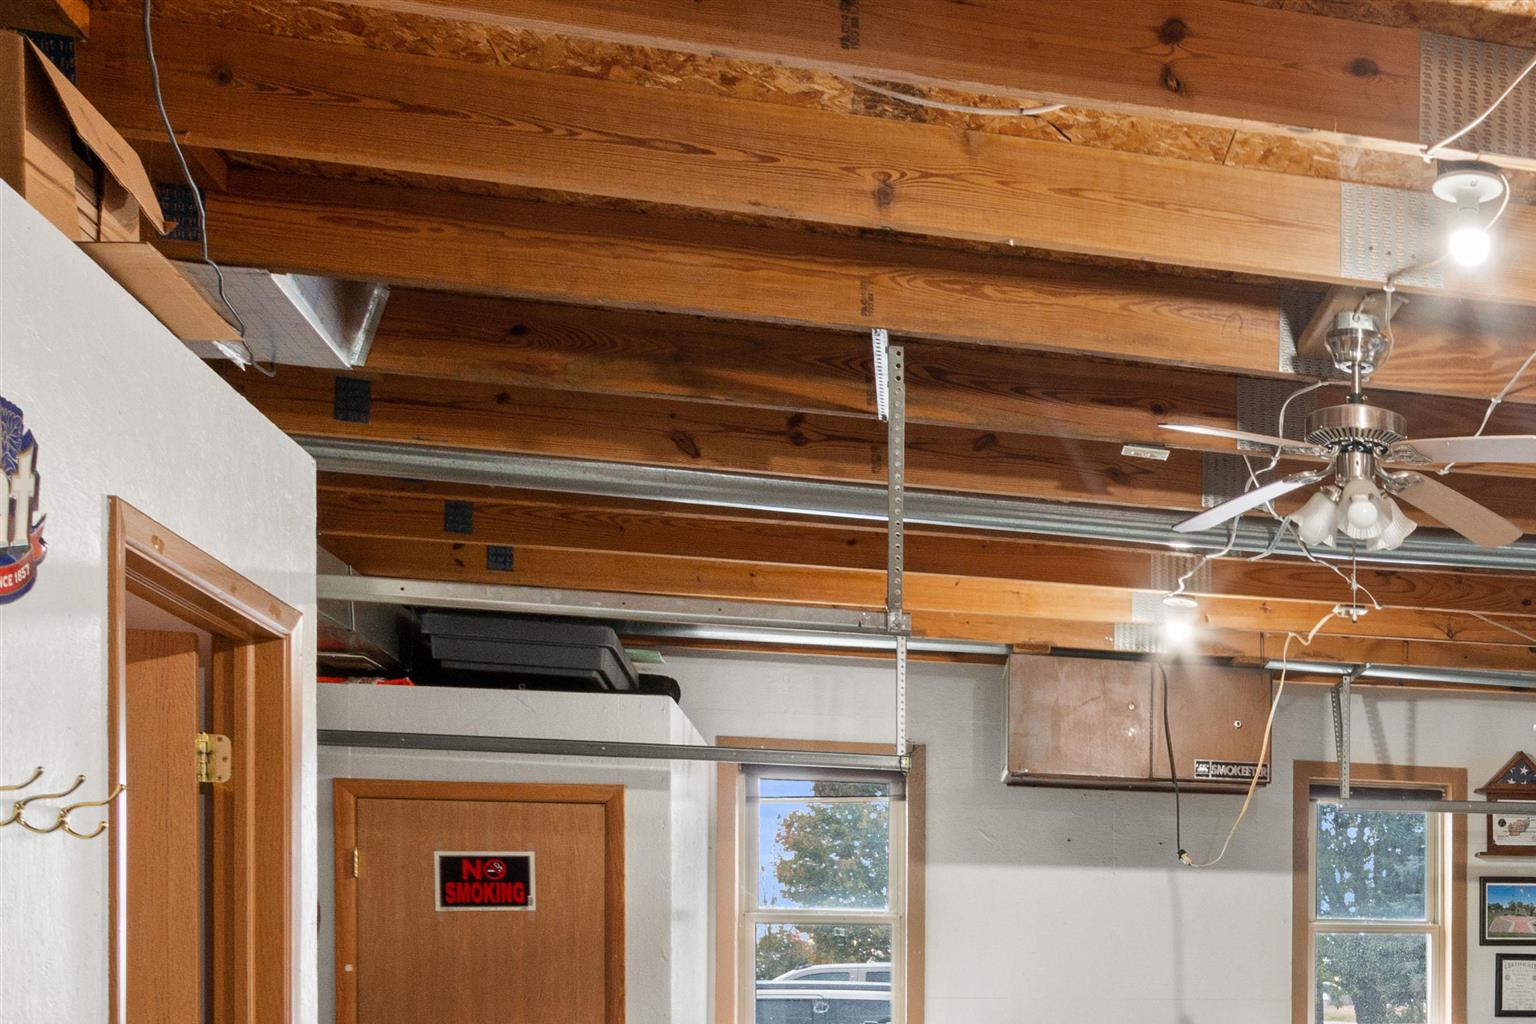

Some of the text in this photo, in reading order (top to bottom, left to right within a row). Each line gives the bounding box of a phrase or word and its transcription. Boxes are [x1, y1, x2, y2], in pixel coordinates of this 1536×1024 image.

[14, 563, 30, 584] 1857
[461, 858, 507, 880] NO
[445, 881, 525, 904] SMOKING
